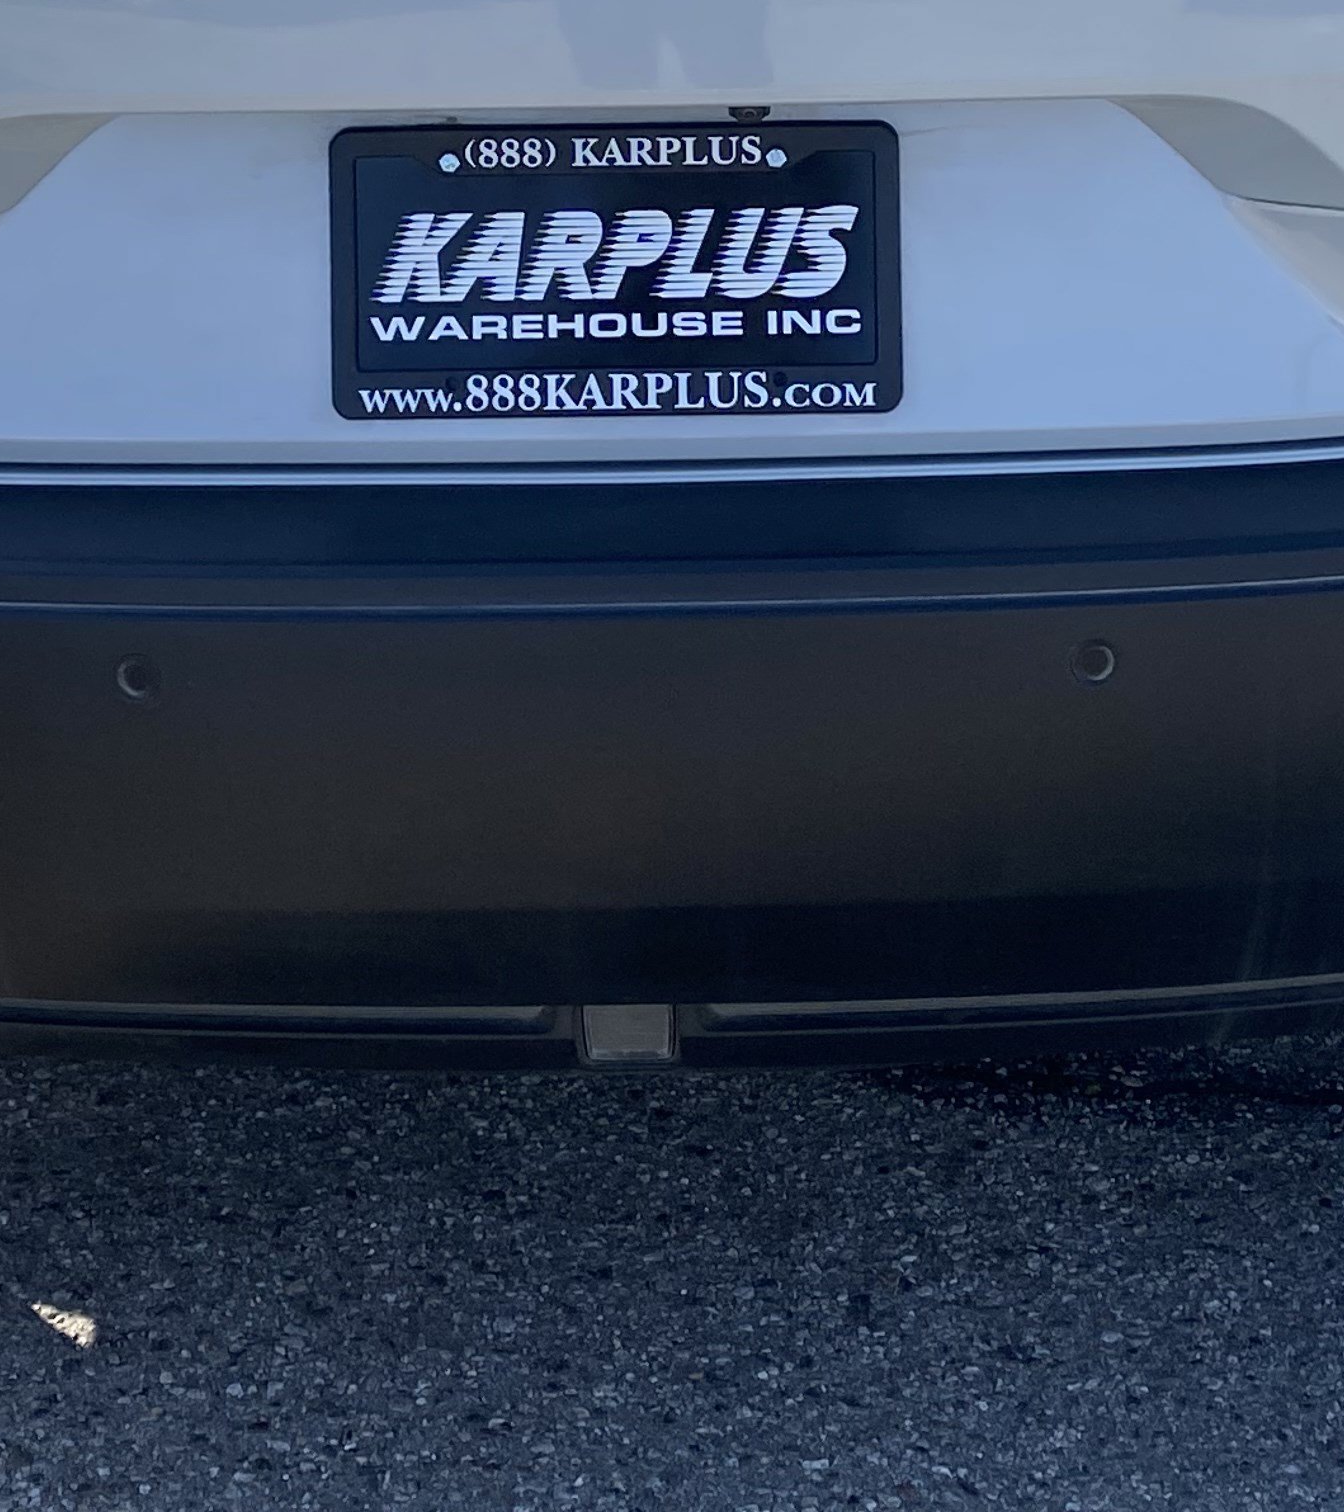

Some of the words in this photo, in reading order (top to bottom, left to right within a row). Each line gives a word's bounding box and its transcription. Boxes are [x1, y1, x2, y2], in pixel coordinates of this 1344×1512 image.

[464, 137, 557, 170] (888)
[571, 135, 762, 168] KARPLUS
[369, 204, 860, 303] KARPLUS
[369, 310, 744, 342] WAREHOUSE
[767, 308, 862, 336] INC
